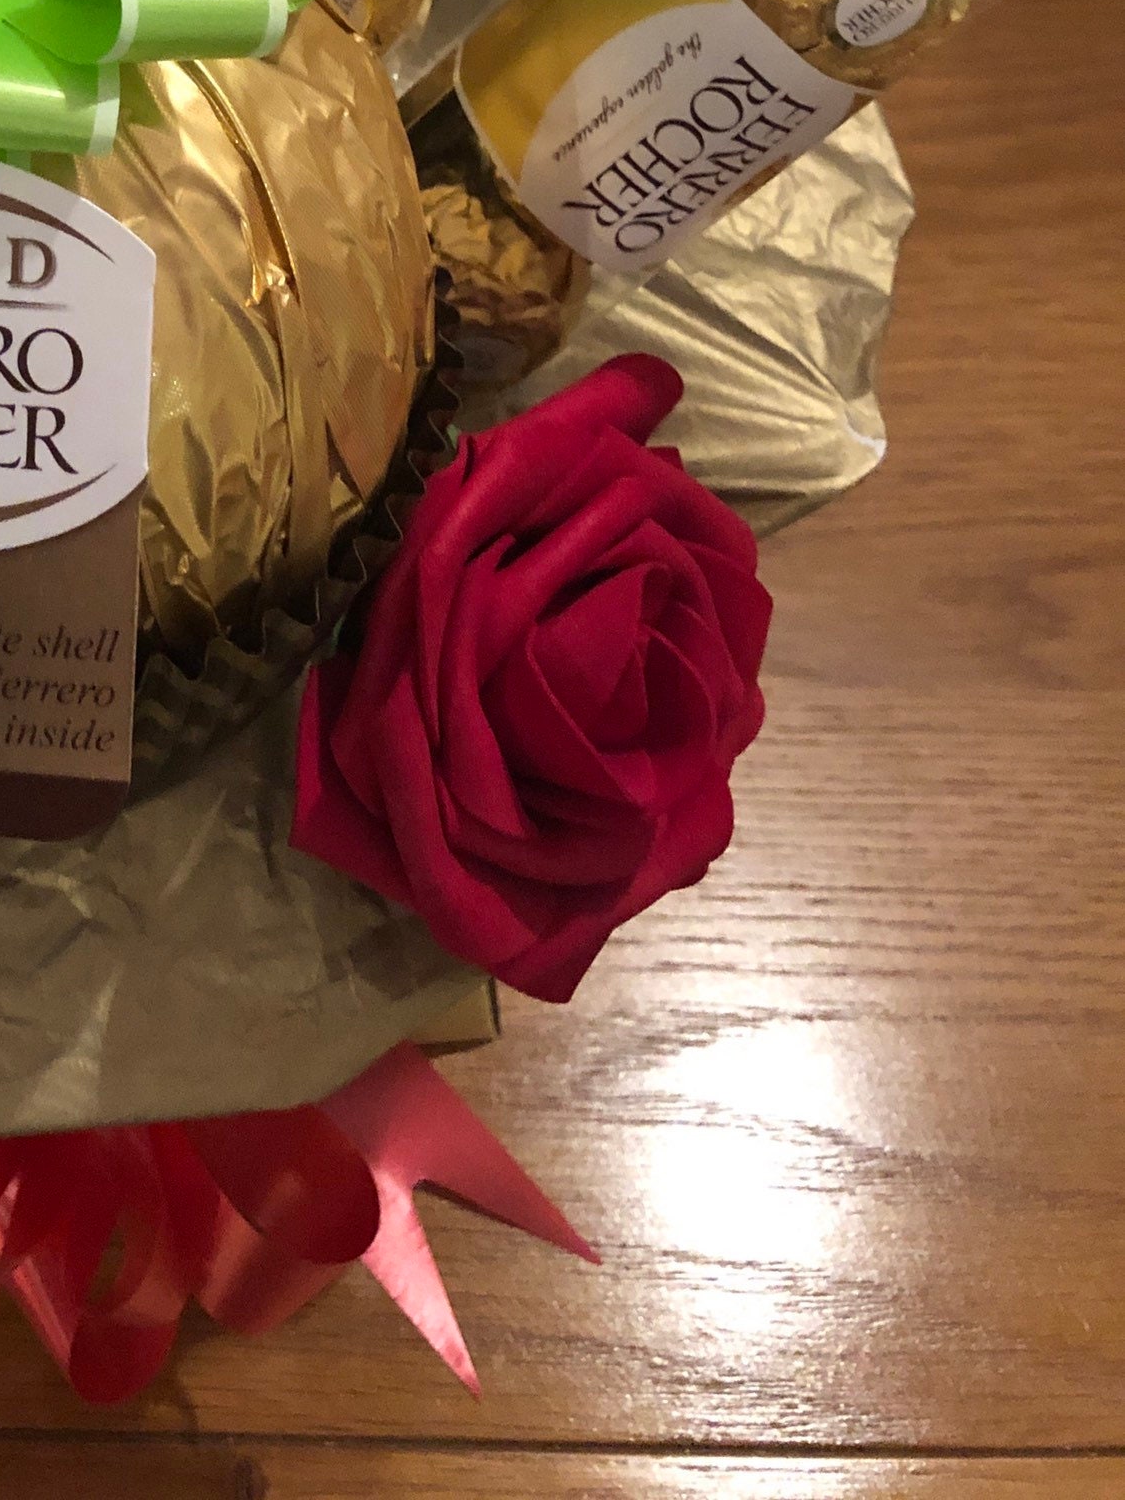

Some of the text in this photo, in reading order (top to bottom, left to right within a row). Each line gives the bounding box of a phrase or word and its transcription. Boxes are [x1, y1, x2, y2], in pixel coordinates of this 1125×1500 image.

[676, 31, 702, 60] the
[627, 41, 675, 100] golden
[559, 54, 780, 229] ROCHER
[613, 92, 818, 255] FERRERO
[32, 623, 120, 663] shell
[3, 714, 115, 752] inside
